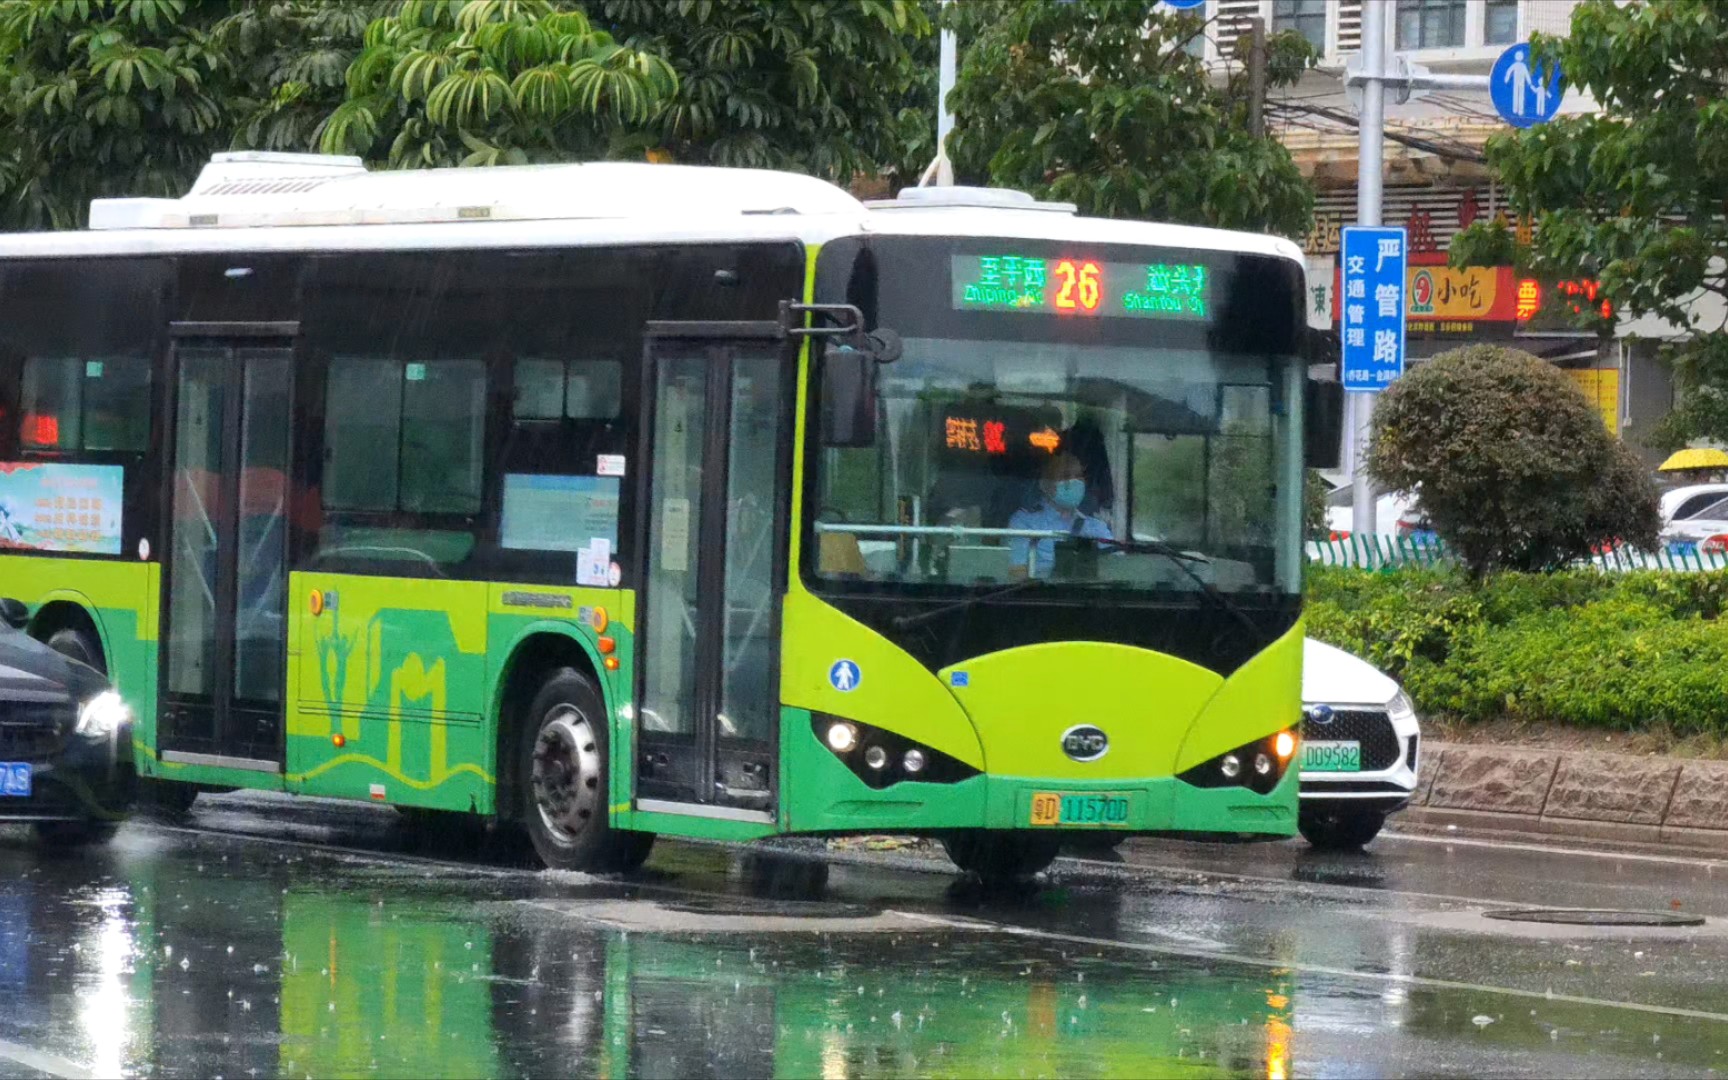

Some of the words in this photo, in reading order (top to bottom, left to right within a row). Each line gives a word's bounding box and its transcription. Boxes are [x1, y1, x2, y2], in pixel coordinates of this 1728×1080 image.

[1055, 260, 1099, 309] 26
[1346, 255, 1365, 347] 交通管理
[1372, 238, 1401, 364] 严管路
[1438, 274, 1482, 309] 小吃
[1306, 746, 1358, 767] D09582
